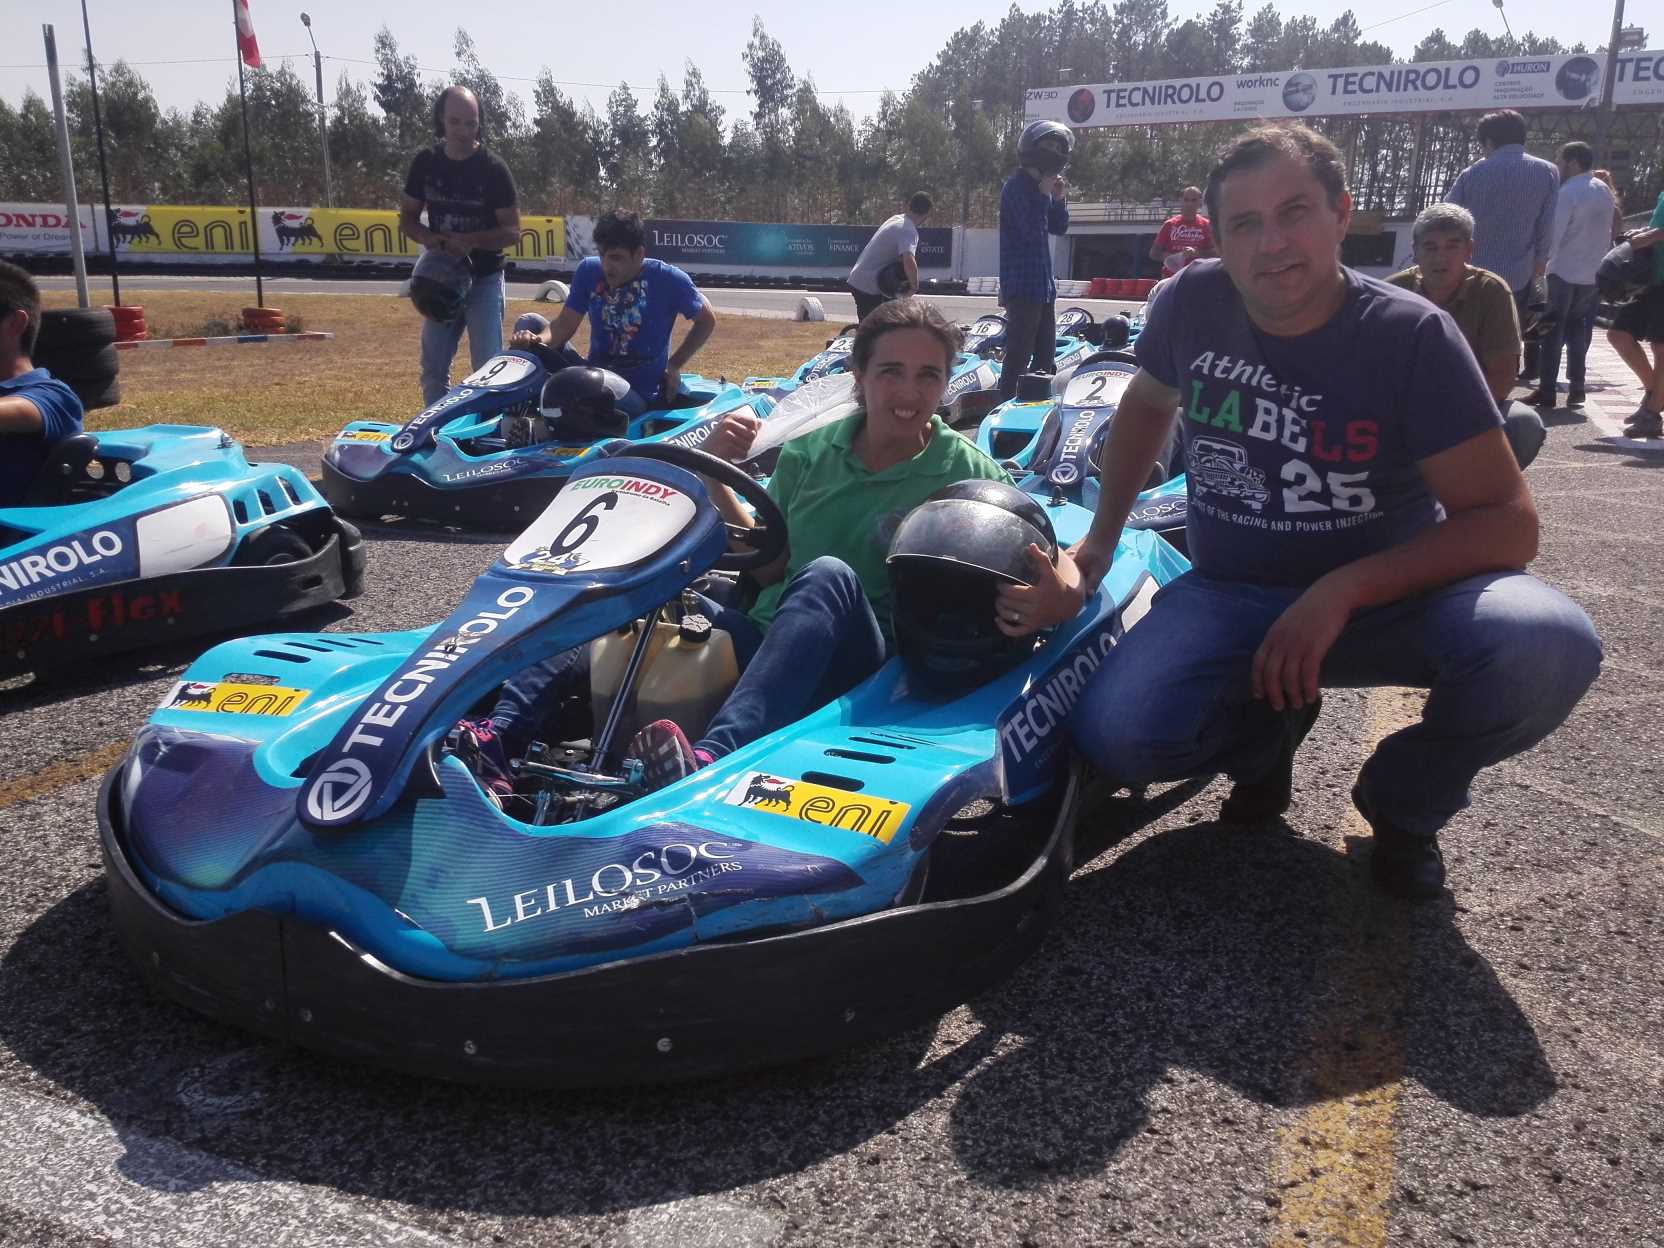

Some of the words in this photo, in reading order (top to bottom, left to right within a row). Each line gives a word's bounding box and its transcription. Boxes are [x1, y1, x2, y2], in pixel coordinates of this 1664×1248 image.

[1327, 65, 1480, 96] TECNIROLO
[1512, 63, 1548, 72] HURON
[1103, 81, 1225, 109] TECNIROLO
[1236, 76, 1280, 90] worknc
[32, 232, 40, 241] of
[172, 209, 250, 251] eni
[502, 219, 556, 258] ni
[653, 230, 726, 248] LEILOSOC
[975, 323, 991, 334] 16
[1061, 313, 1074, 323] 28
[480, 361, 507, 382] 9
[1189, 351, 1323, 412] Athletic
[1085, 376, 1107, 403] 2
[1060, 410, 1096, 462] TECNIROLO
[1187, 380, 1379, 463] LABELS
[573, 477, 678, 499] EUROINDY
[1280, 458, 1376, 513] 25
[550, 491, 619, 556] 6
[1231, 513, 1268, 529] RACING
[1271, 520, 1292, 531] AND
[1295, 521, 1333, 532] POWER
[343, 586, 536, 752] TECNIROLO
[216, 688, 303, 716] eni
[798, 795, 898, 839] eni
[466, 841, 736, 932] LEILOSOC
[658, 861, 743, 896] PARTNERS
